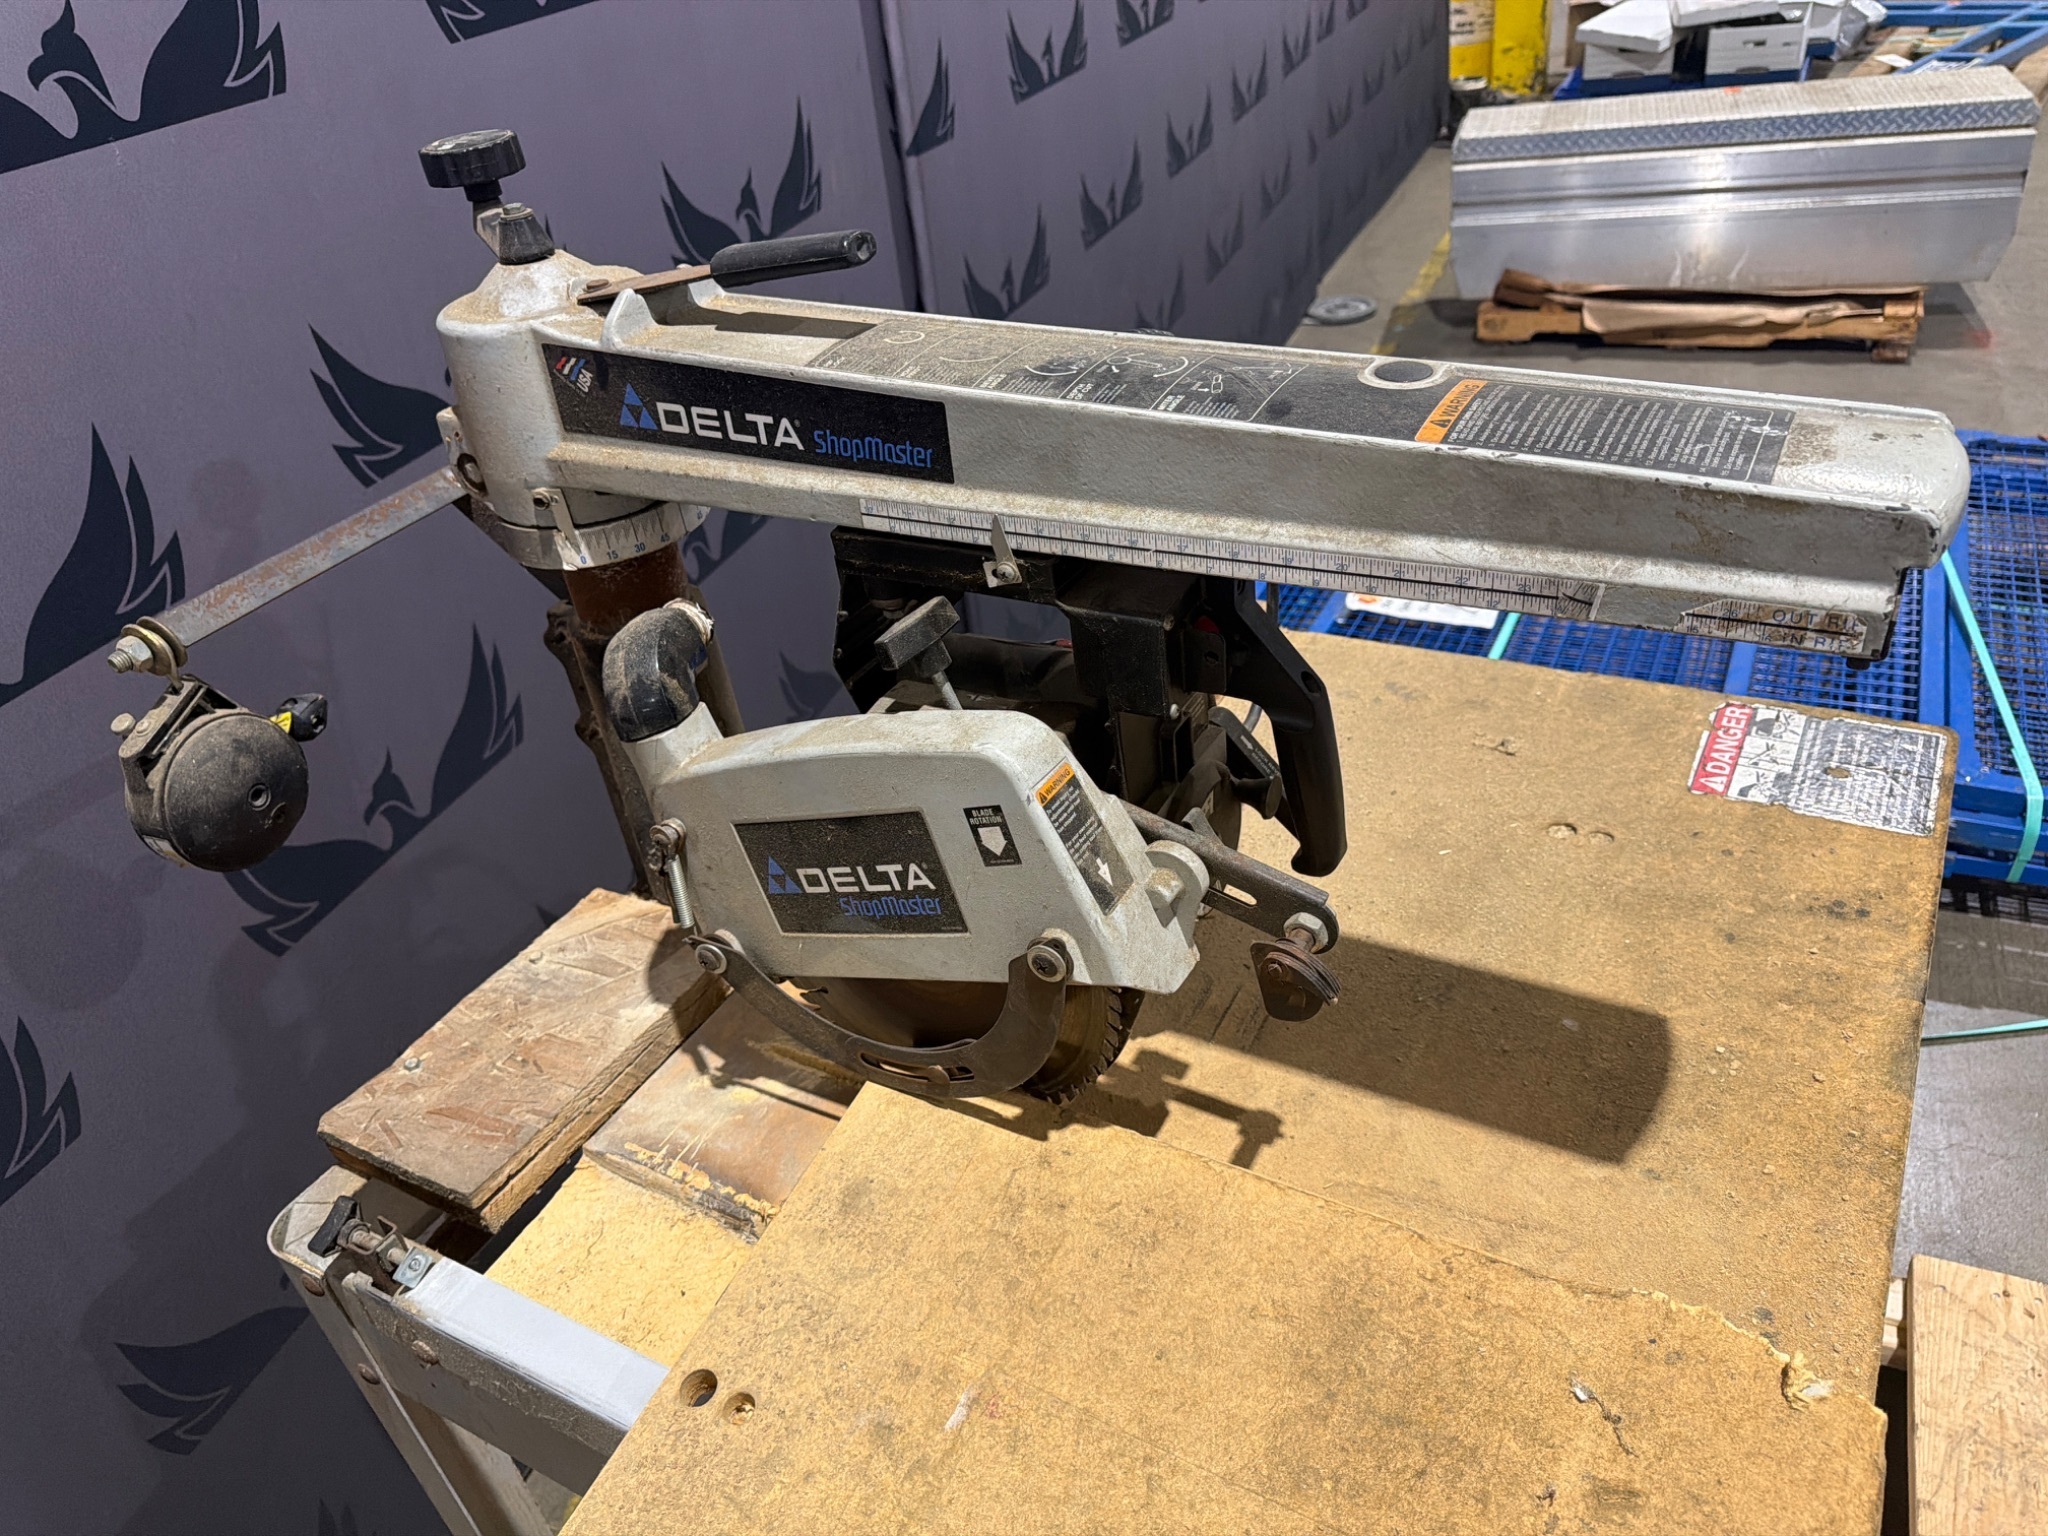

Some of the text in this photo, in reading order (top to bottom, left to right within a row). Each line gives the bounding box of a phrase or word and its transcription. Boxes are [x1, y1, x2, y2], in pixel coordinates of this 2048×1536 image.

[576, 368, 593, 392] USA
[1439, 384, 1480, 417] WARNING
[656, 402, 933, 468] DELTA ShopMaster
[580, 556, 586, 564] 0
[607, 551, 618, 560] 15
[634, 542, 646, 553] 30
[660, 533, 671, 543] 45
[1455, 576, 1468, 584] 22
[1518, 584, 1531, 592] 23
[1722, 609, 1738, 617] 26
[1772, 609, 1817, 625] OUT
[1783, 632, 1804, 645] IN
[1711, 706, 1752, 780] DANGER
[1044, 768, 1070, 796] WARNING
[970, 816, 1002, 825] ROTATION
[971, 808, 994, 817] BLADE
[796, 862, 936, 893] DELTA
[839, 895, 942, 919] ShopMaster
